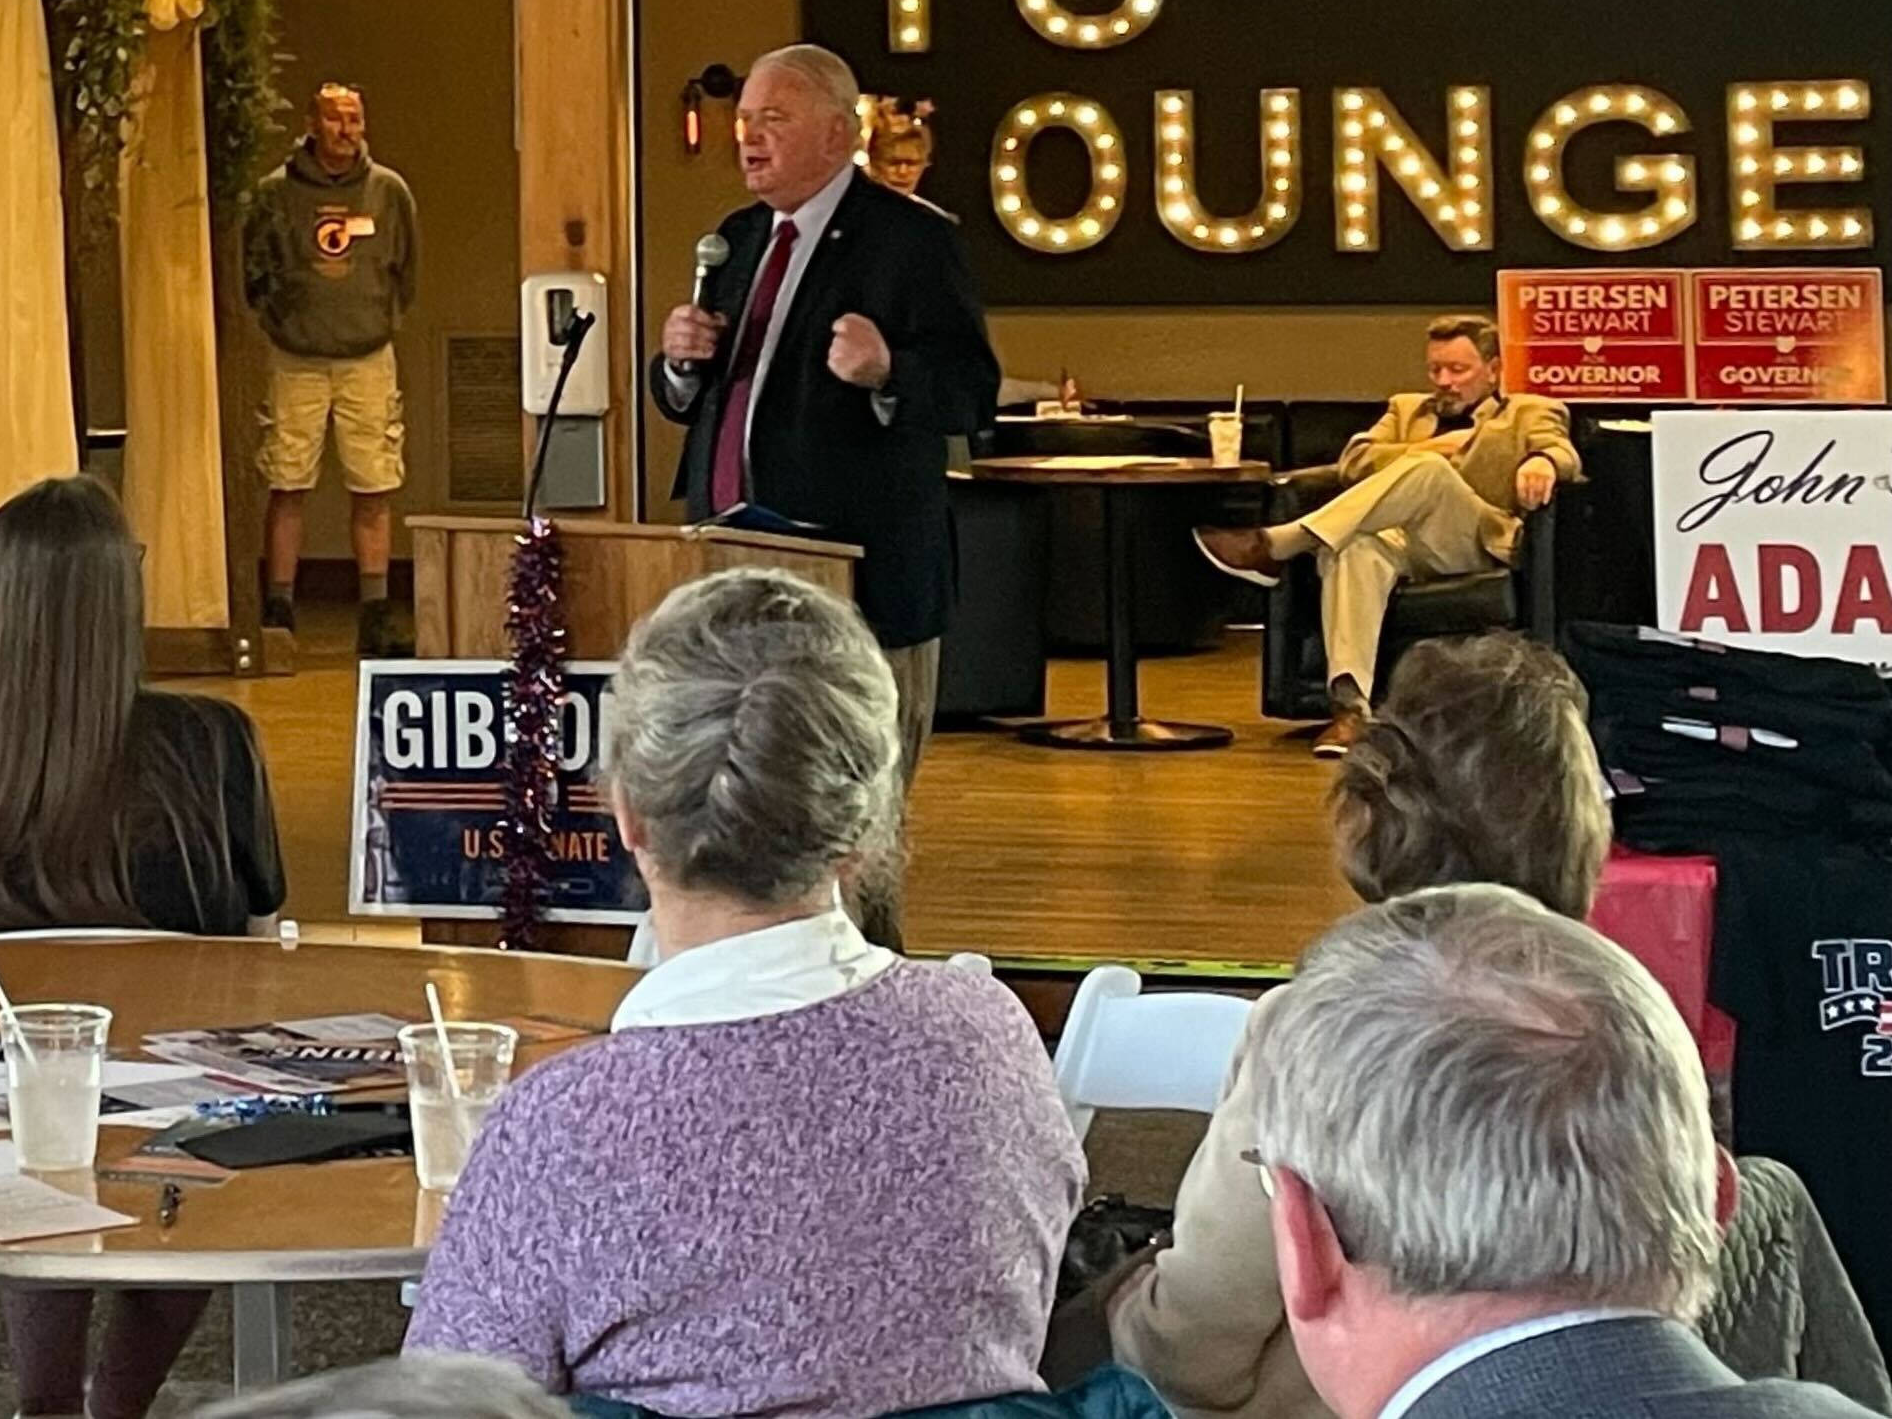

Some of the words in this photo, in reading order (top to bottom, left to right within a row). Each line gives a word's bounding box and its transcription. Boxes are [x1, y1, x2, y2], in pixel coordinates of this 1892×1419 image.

[856, 77, 1874, 255] OUNGE
[1518, 284, 1668, 310] PETERSEN
[1709, 284, 1861, 310] PETERSEN
[1533, 310, 1653, 333] STEWART
[1528, 365, 1661, 385] GOVERNOR
[1677, 430, 1866, 533] John
